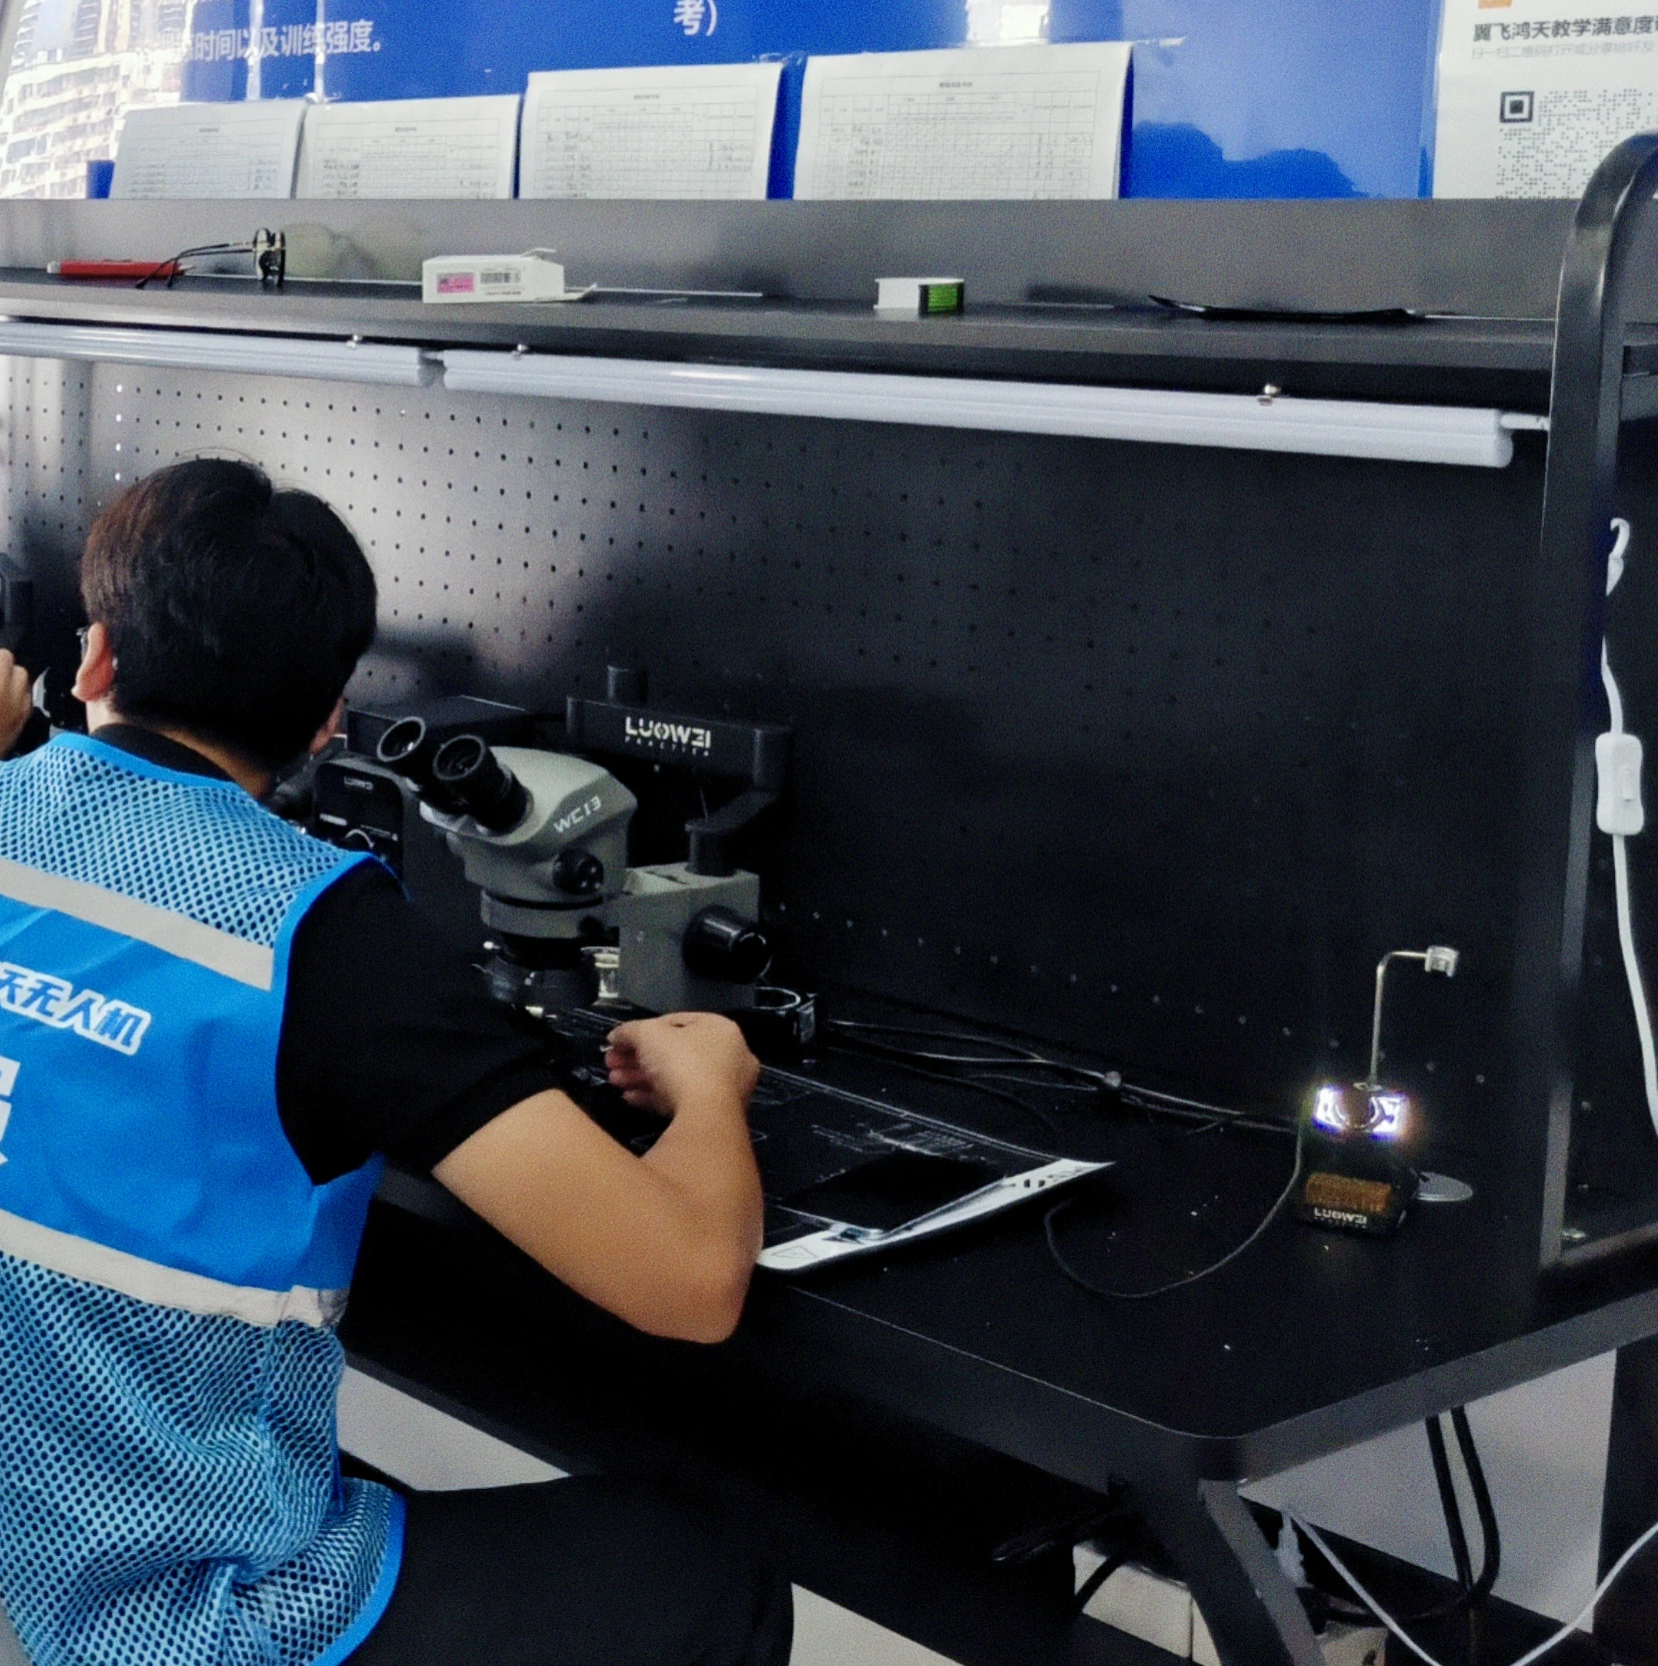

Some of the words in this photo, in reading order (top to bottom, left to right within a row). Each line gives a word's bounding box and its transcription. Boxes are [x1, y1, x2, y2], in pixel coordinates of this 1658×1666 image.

[1474, 15, 1658, 42] 翼飞鸿天教学满意度
[553, 795, 601, 833] WC13
